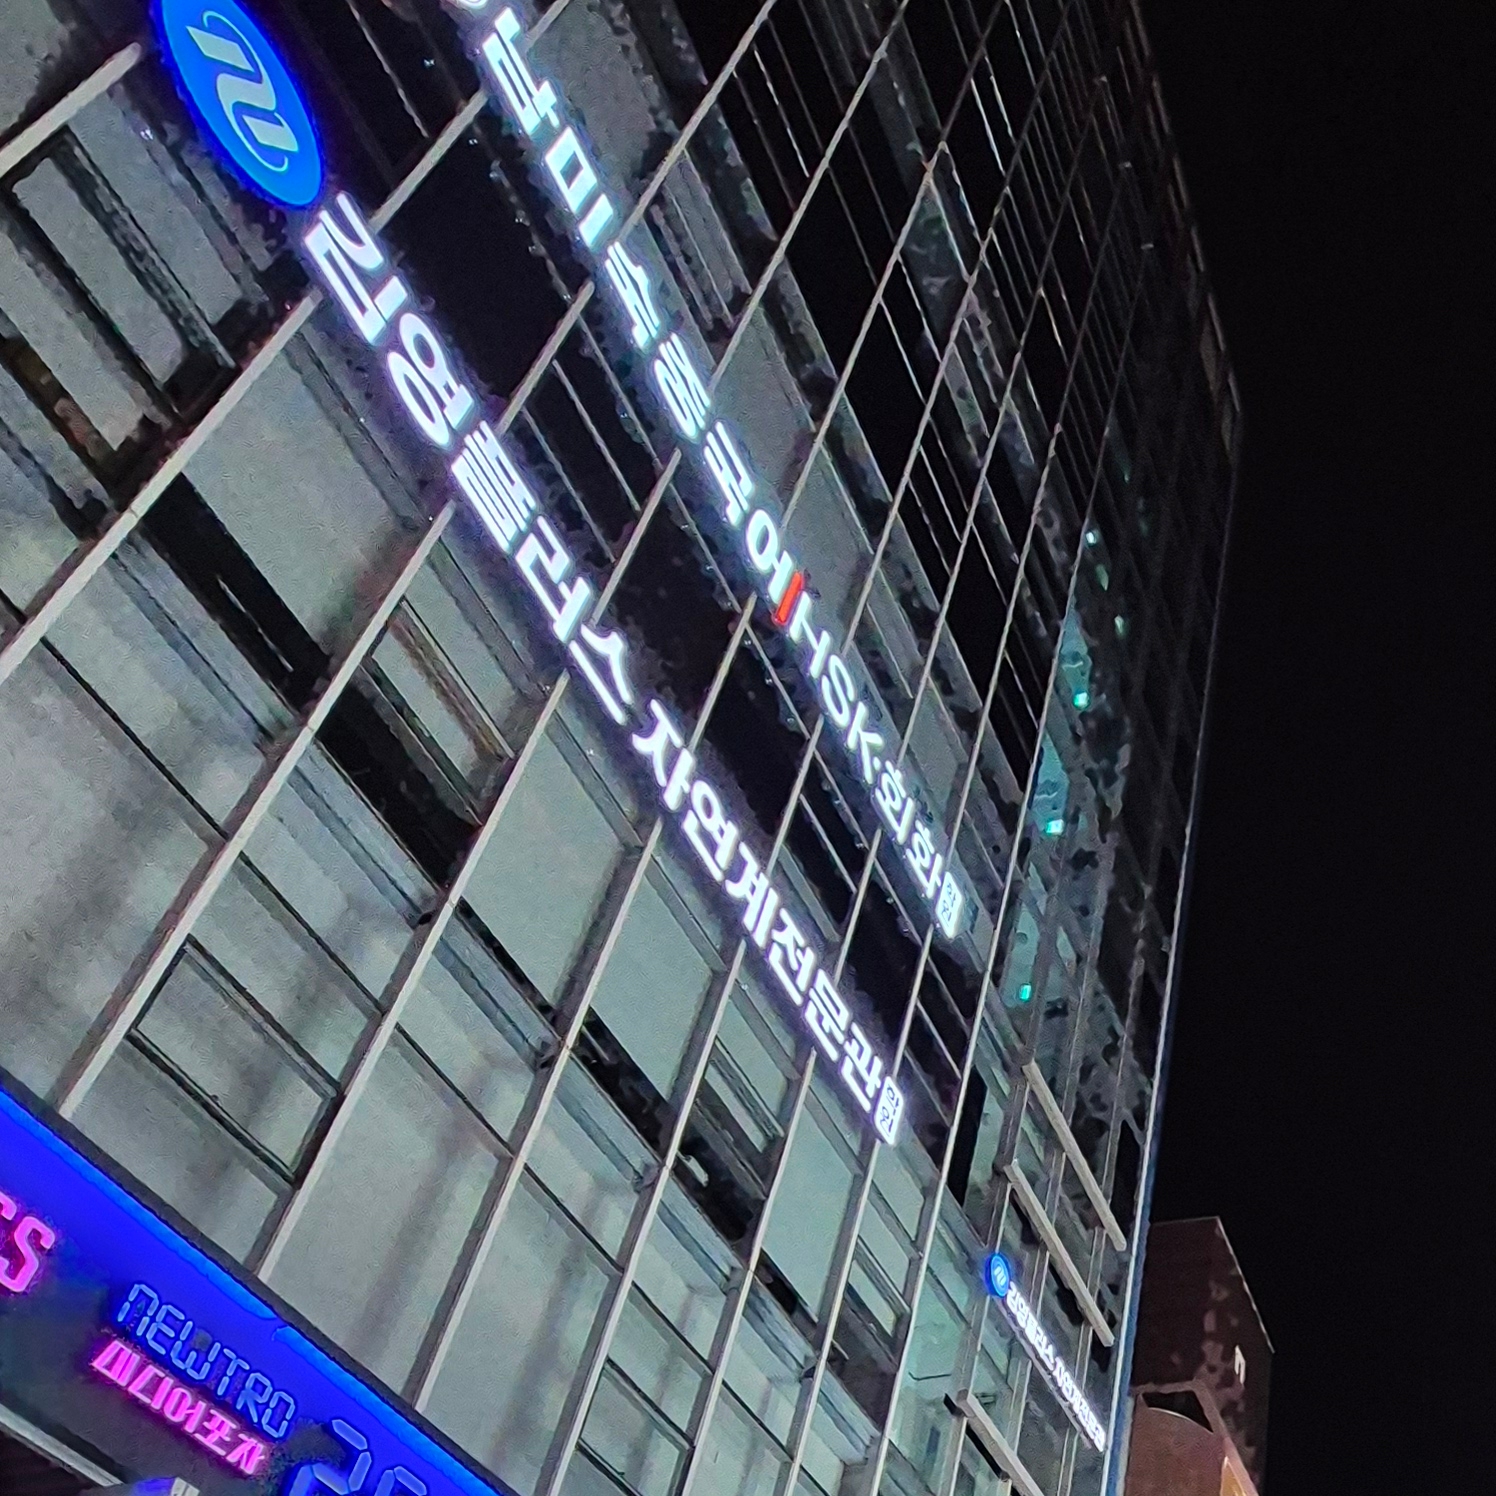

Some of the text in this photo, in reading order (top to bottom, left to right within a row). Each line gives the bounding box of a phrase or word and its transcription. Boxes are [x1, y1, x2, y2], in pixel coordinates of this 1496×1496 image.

[455, 0, 794, 606] 남미숙중국어
[304, 192, 634, 724] 김영플러스
[632, 700, 883, 1113] 자연계전문관
[91, 1340, 266, 1475] 미디어포차
